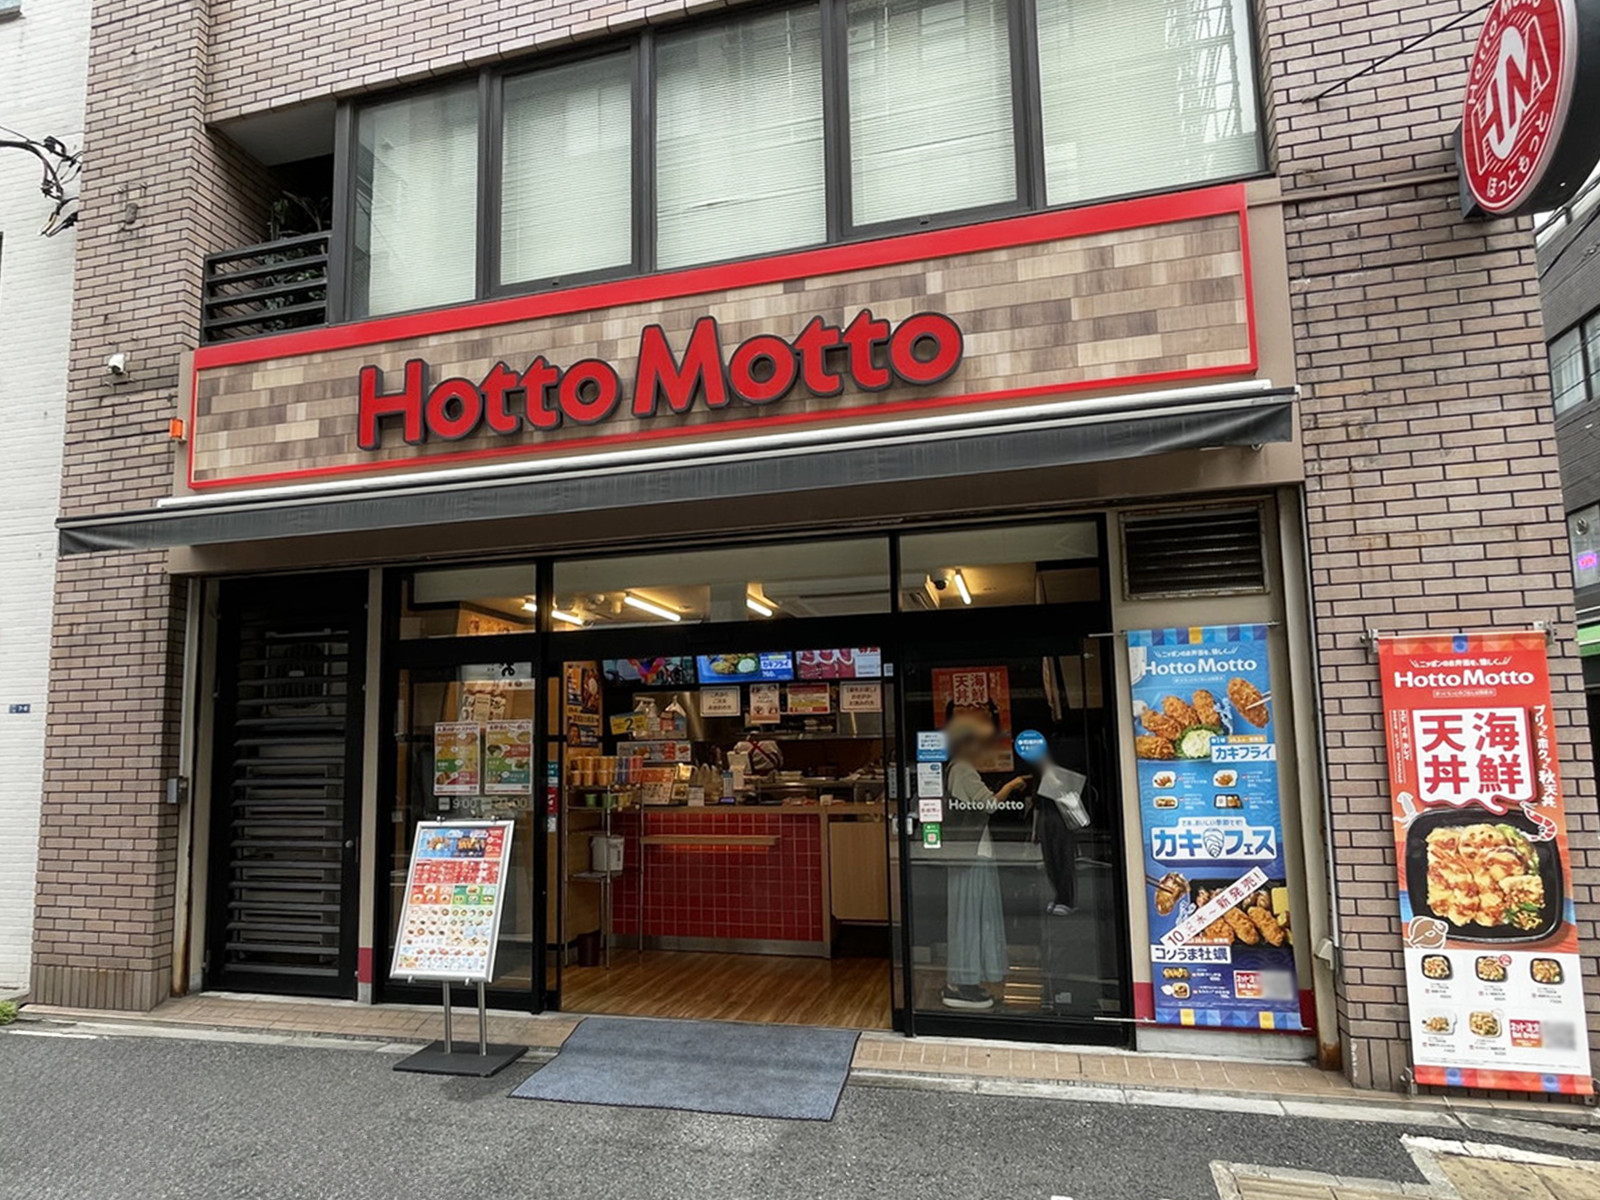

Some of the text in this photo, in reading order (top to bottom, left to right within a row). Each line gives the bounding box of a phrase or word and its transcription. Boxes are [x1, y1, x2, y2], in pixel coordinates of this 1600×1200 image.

[1487, 111, 1549, 198] ほっともっと
[357, 309, 965, 450] Hotto Motto
[1142, 658, 1257, 676] Hotto Motto
[1394, 668, 1535, 688] Hotto Motto
[1216, 746, 1272, 760] カキフライ
[1420, 714, 1470, 794] 天丼
[1472, 712, 1524, 794] 海鮮
[949, 799, 984, 810] Hotto
[986, 799, 1025, 810] Motto
[1154, 829, 1275, 857] カキフェス
